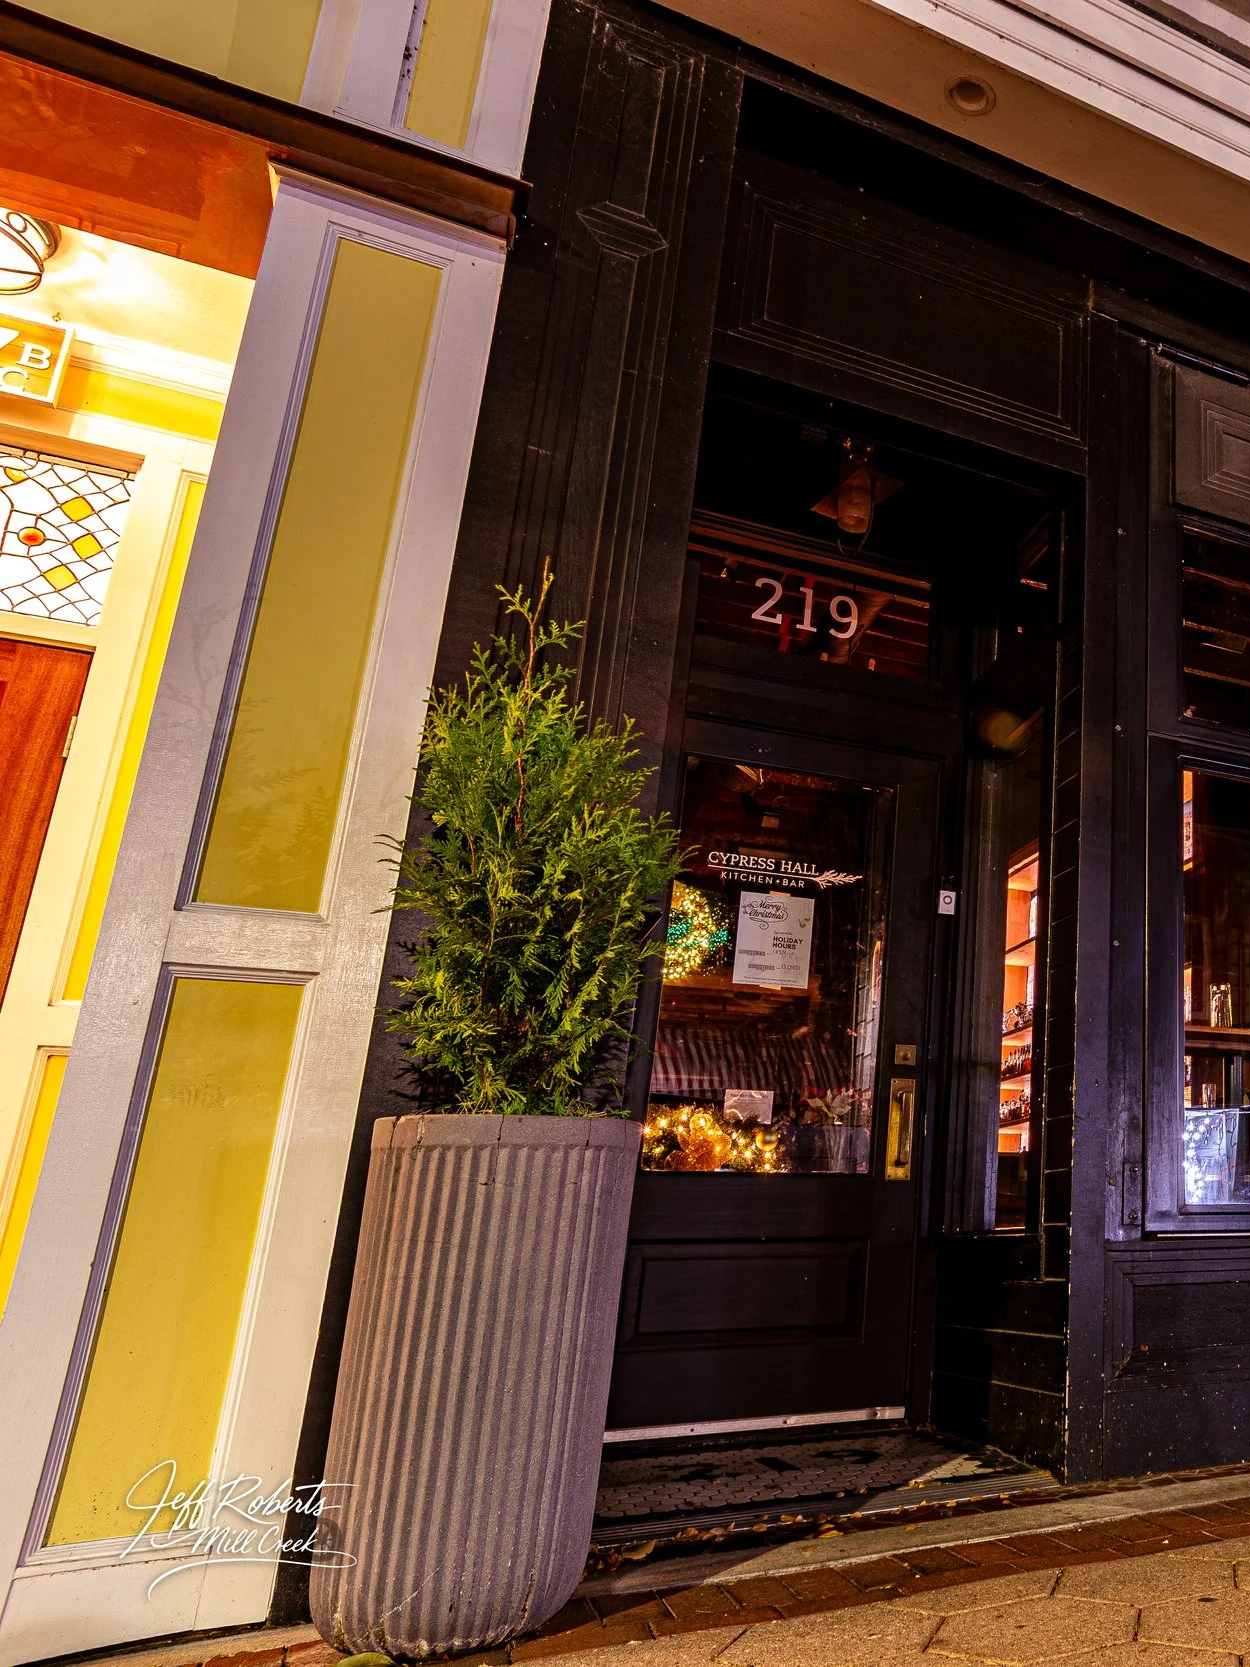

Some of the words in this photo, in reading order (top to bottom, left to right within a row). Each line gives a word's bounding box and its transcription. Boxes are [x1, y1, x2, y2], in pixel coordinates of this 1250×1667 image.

[16, 341, 52, 370] B
[751, 577, 859, 639] 219
[708, 851, 775, 870] CYPRESS
[780, 860, 819, 876] HALL
[757, 899, 782, 913] Merry
[749, 908, 785, 920] Christmas
[772, 936, 803, 945] HOLIDAY
[772, 942, 797, 950] HOURS
